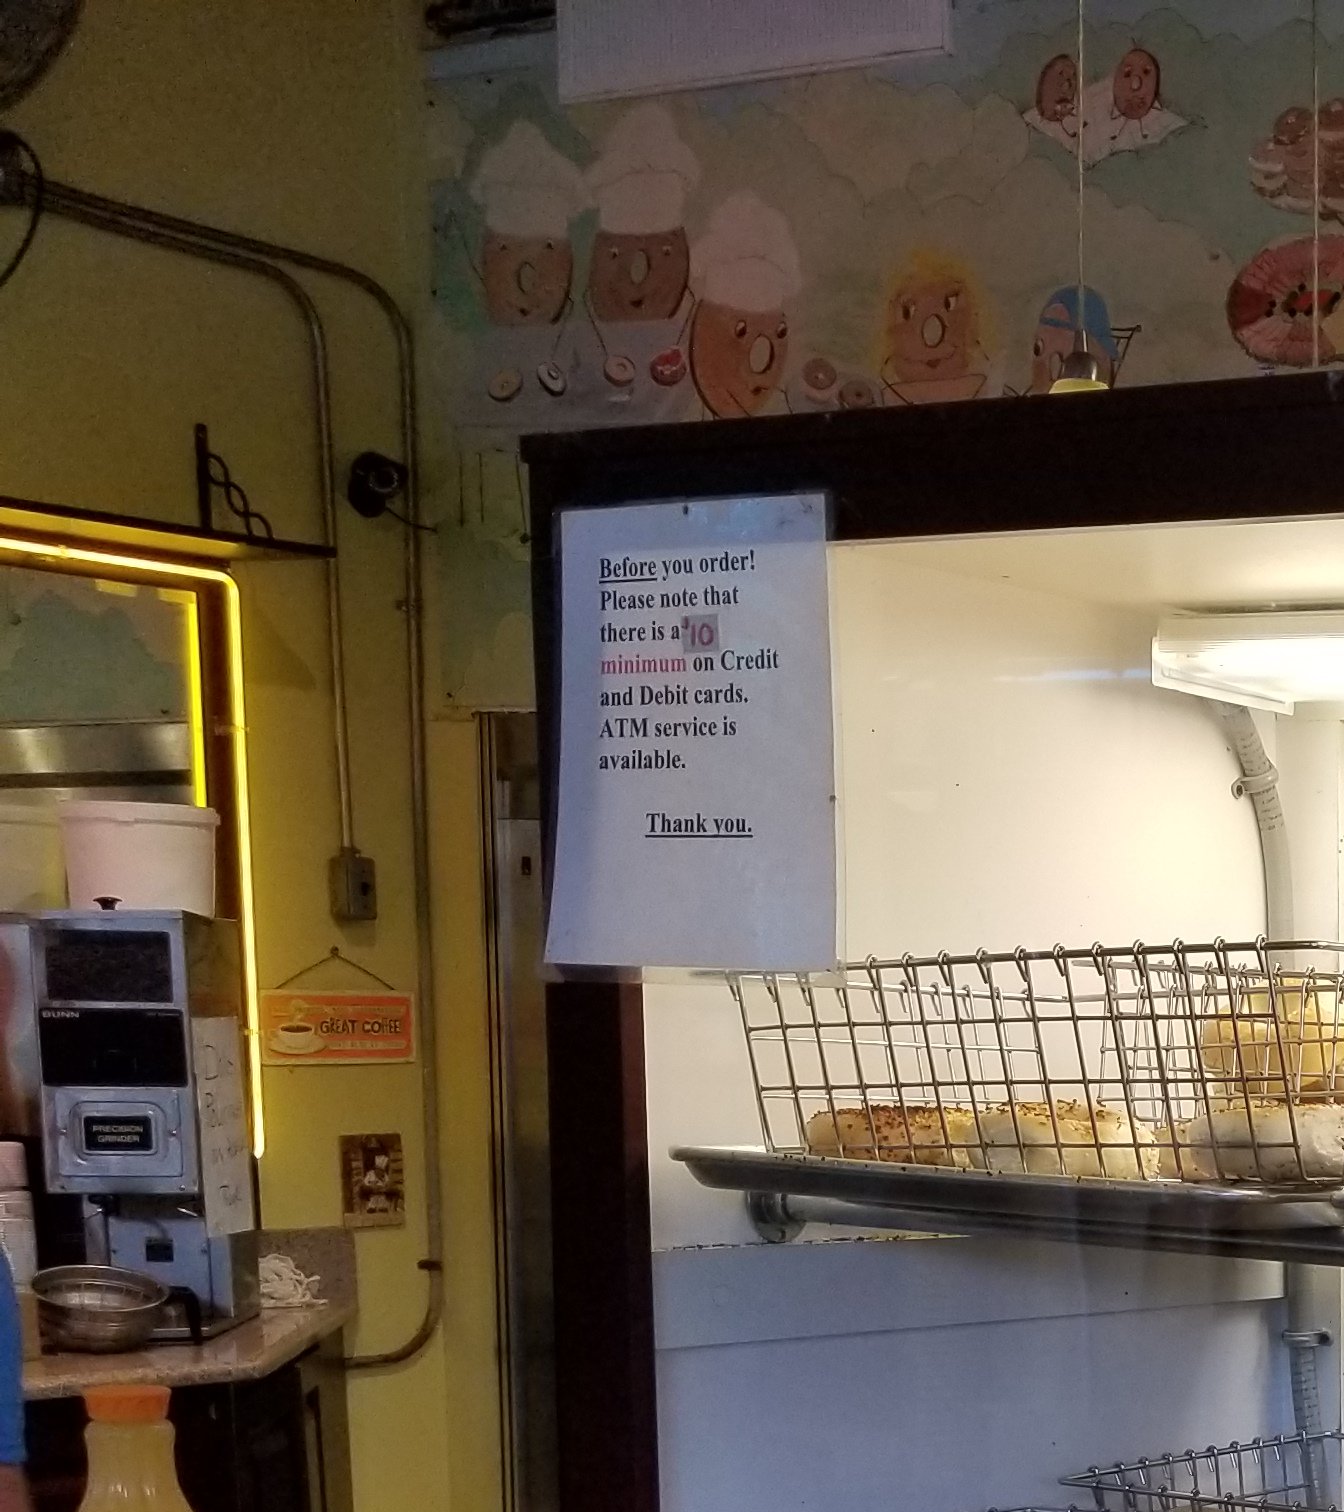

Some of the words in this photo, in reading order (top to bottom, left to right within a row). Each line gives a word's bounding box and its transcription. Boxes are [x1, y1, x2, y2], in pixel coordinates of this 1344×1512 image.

[599, 557, 658, 581] Before
[662, 558, 694, 582] you
[700, 550, 755, 573] order!
[600, 590, 655, 611] Please
[660, 587, 698, 607] note
[704, 585, 739, 606] that
[600, 621, 646, 642] there
[652, 621, 665, 640] is
[671, 625, 680, 640] a
[600, 655, 687, 674] minimum
[693, 656, 714, 672] on
[721, 649, 779, 671] Credit
[600, 685, 633, 706] and
[640, 684, 688, 705] Debit
[694, 684, 749, 703] cards.
[599, 718, 647, 738] ATM
[655, 716, 717, 737] service
[722, 716, 737, 736] is
[599, 750, 687, 770] available.
[646, 813, 707, 833] Thank
[713, 816, 753, 835] you.
[320, 1018, 357, 1034] GREAT
[92, 1125, 143, 1133] PRECISION
